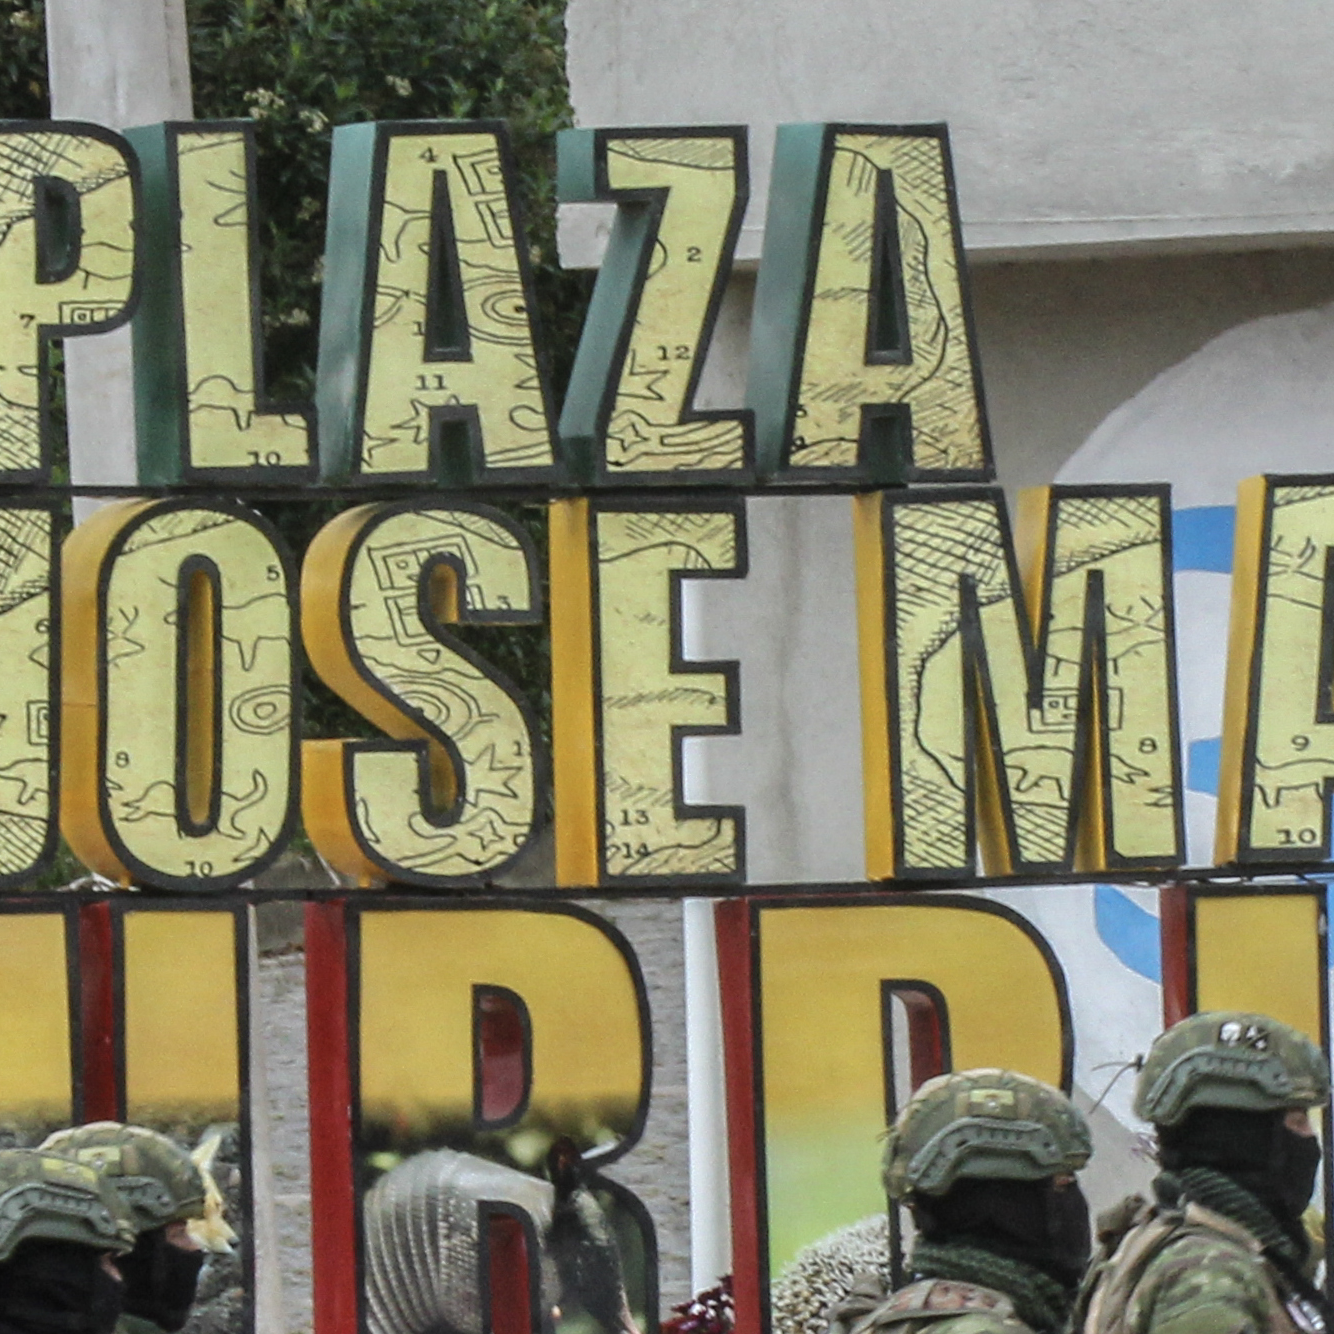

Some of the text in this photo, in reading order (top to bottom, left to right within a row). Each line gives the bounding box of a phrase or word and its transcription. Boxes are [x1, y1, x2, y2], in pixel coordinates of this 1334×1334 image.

[687, 247, 702, 262] 2
[19, 314, 36, 329] 7
[657, 345, 691, 361] 12
[414, 374, 447, 391] 11
[266, 565, 281, 581] 5
[1138, 737, 1157, 754] 8
[1291, 734, 1310, 751] 9
[115, 751, 130, 768] 8
[620, 809, 650, 826] 13
[1276, 828, 1317, 845] 10
